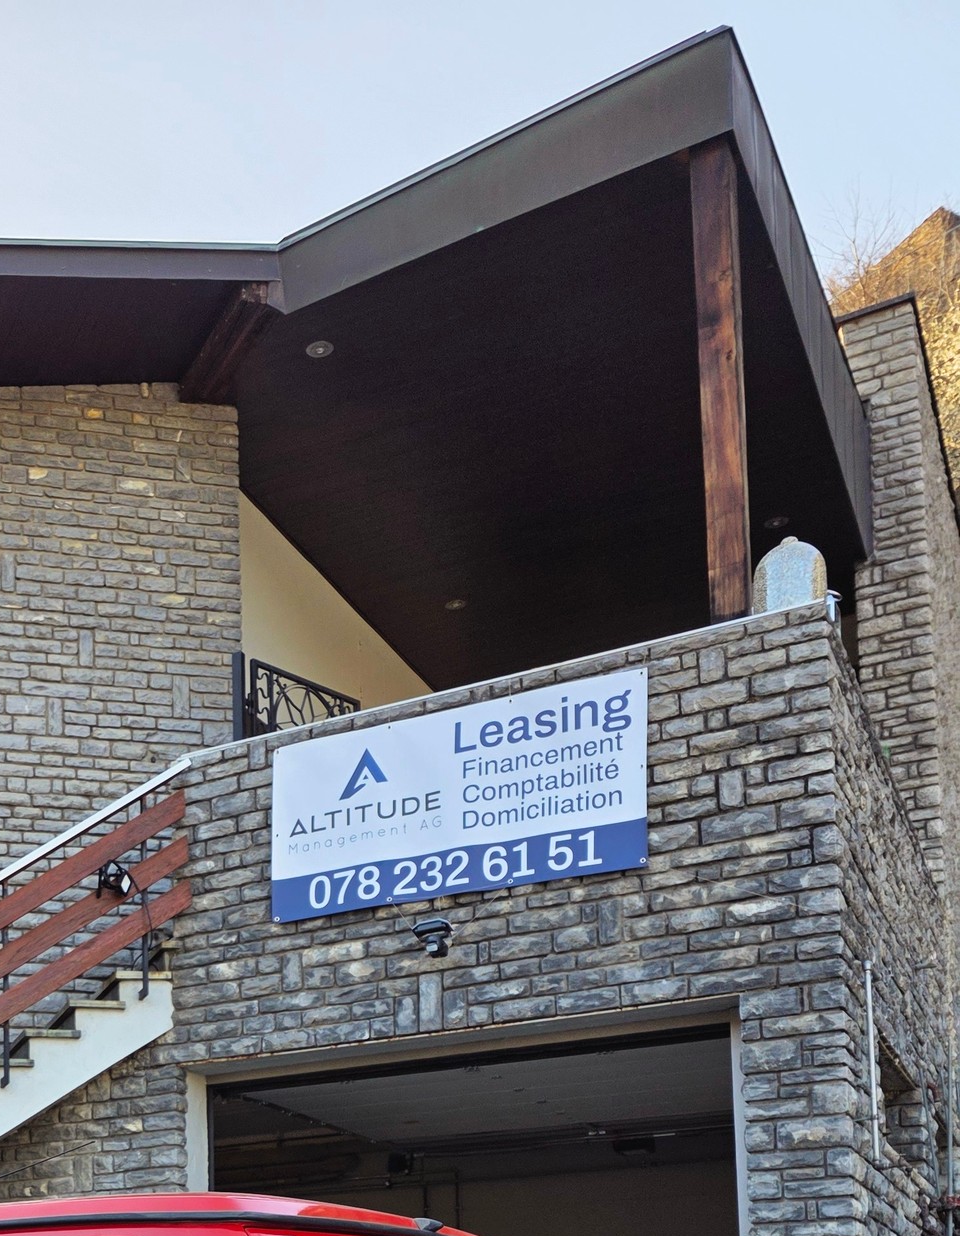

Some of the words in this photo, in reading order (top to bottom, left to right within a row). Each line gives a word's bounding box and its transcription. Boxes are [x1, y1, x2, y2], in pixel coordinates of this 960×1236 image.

[454, 689, 632, 754] Leasing
[462, 732, 623, 779] Financement
[462, 758, 619, 803] Comptabilité
[290, 790, 441, 837] ALTITUDE
[462, 789, 623, 830] Domiciliation
[288, 824, 407, 854] Management
[420, 815, 442, 831] AG
[309, 865, 381, 909] 078
[392, 850, 470, 896] 232
[482, 841, 535, 881] 61
[547, 830, 603, 871] 51
